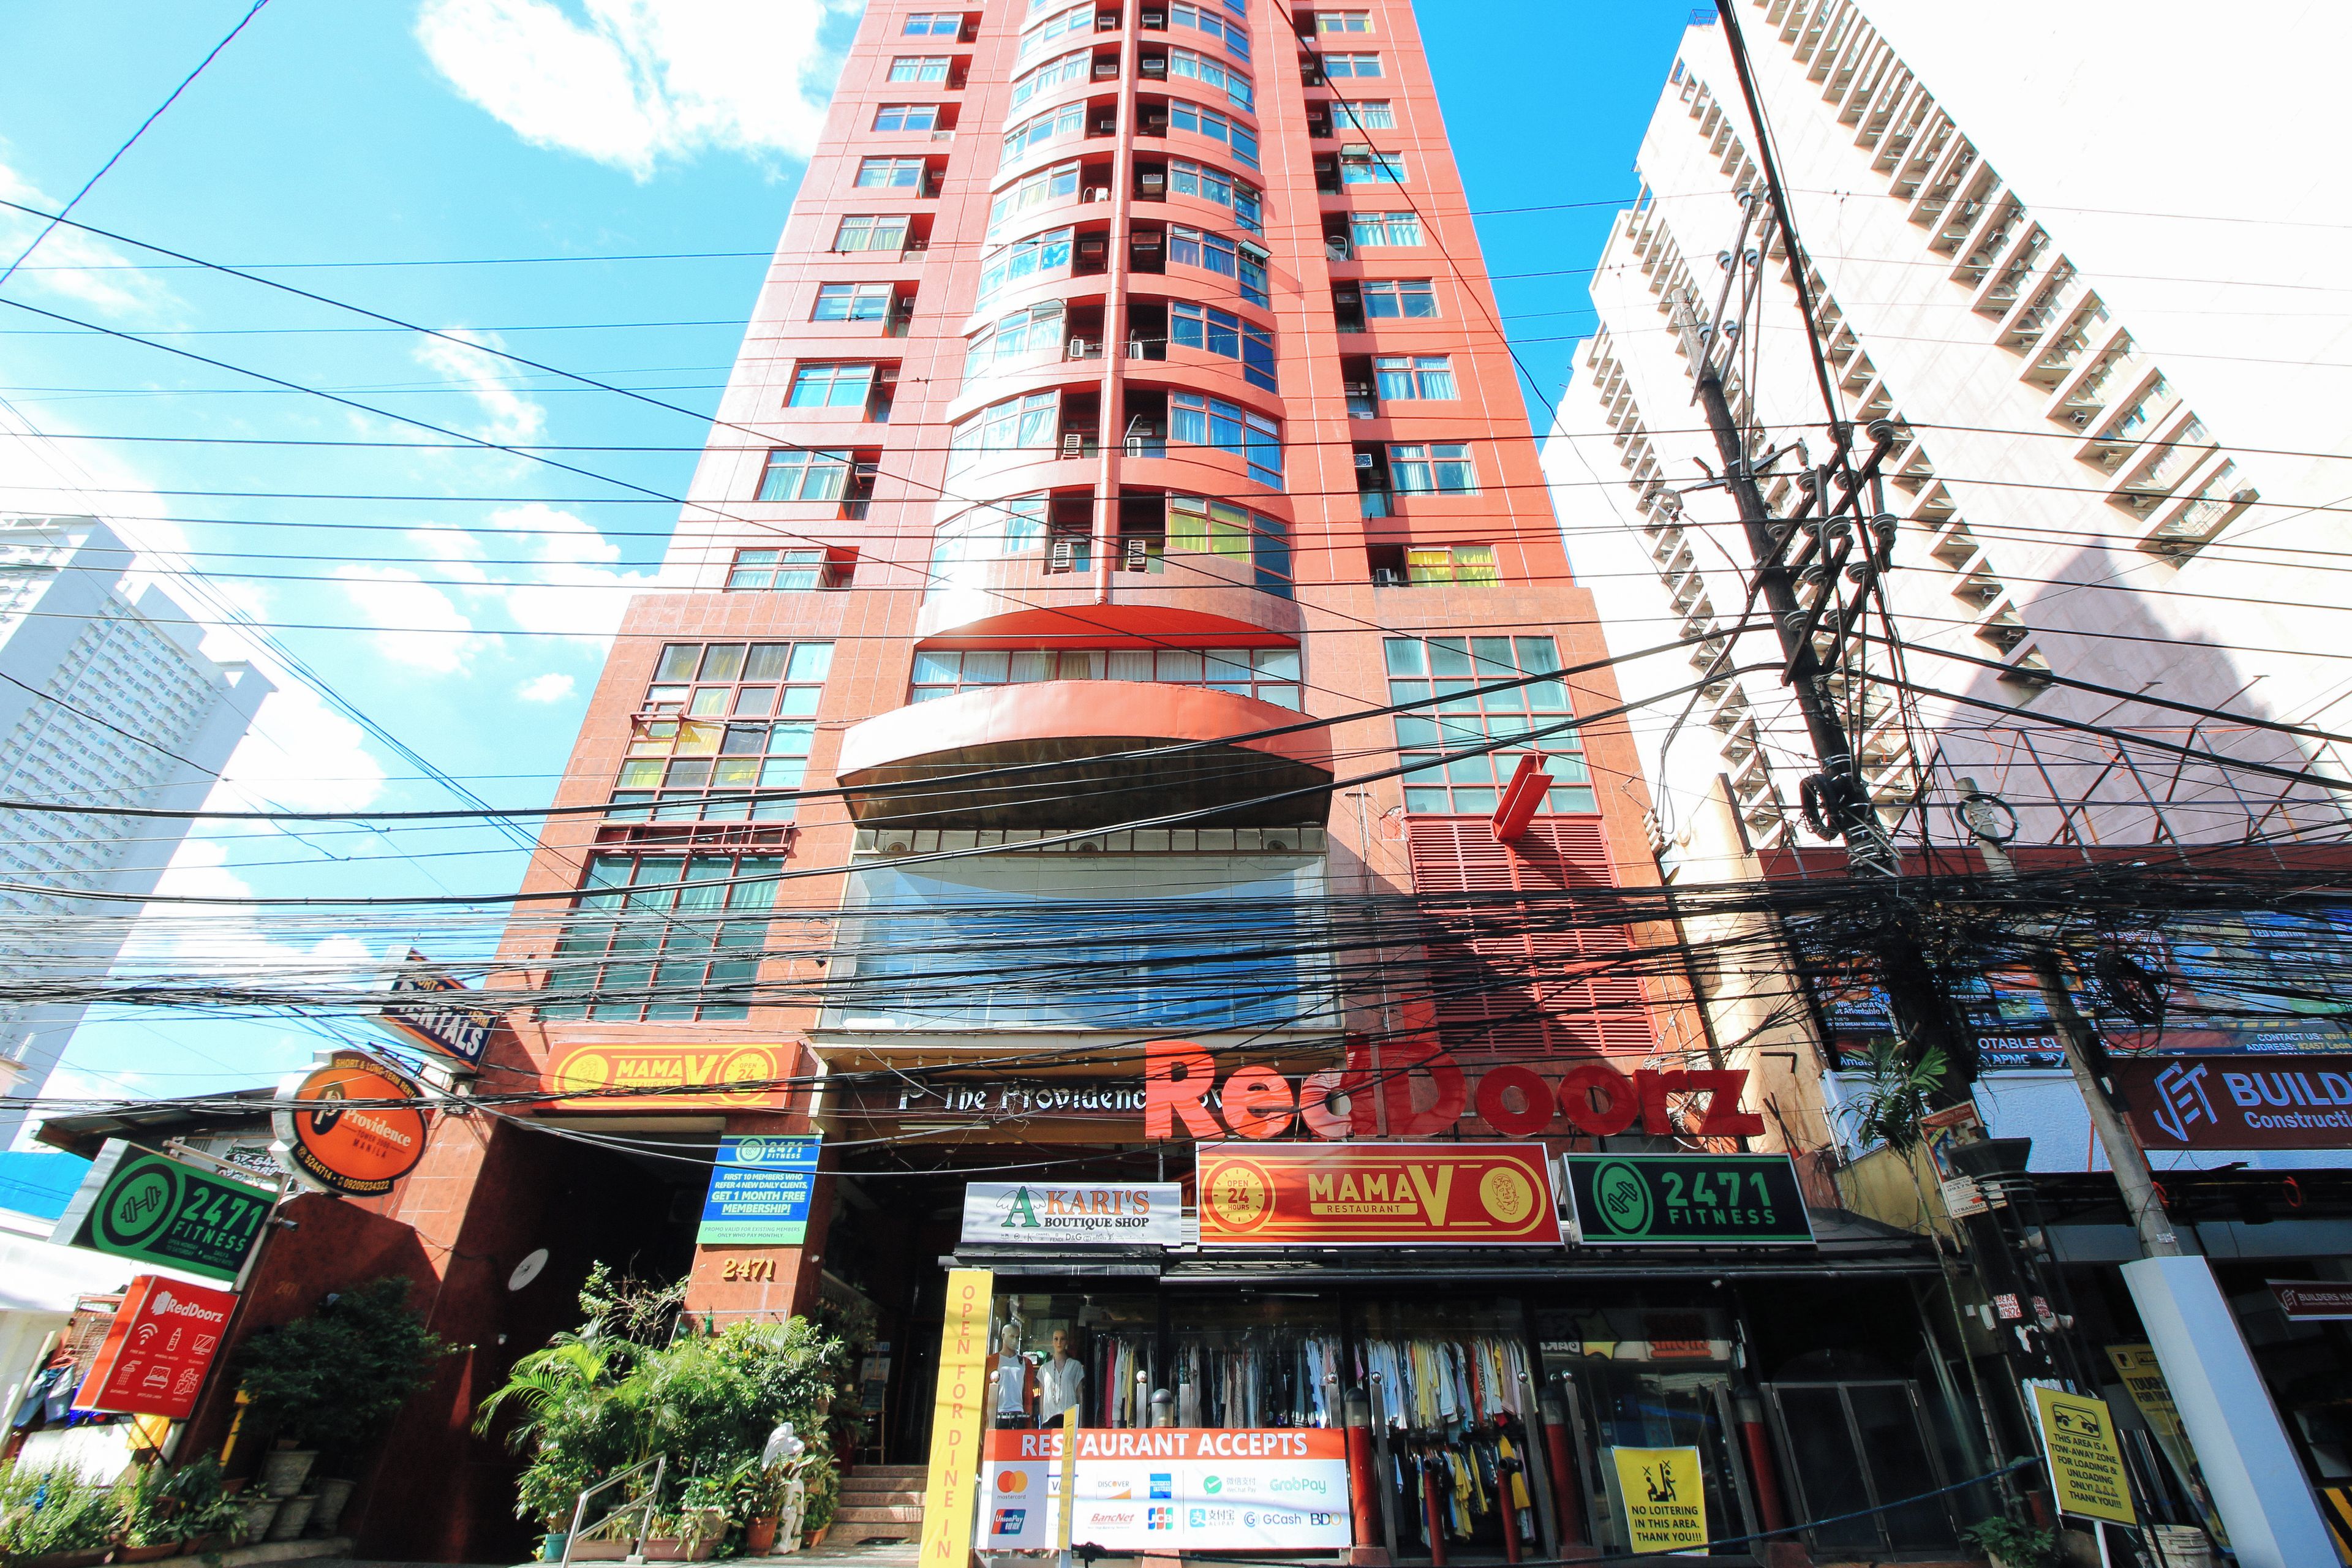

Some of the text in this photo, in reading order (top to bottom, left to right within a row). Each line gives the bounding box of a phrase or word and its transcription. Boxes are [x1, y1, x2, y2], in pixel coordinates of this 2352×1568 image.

[1978, 1038, 2039, 1049] OTABLE
[2256, 1033, 2305, 1042] CONTACT
[2245, 1043, 2297, 1052] ADDRESS:
[336, 1058, 360, 1069] SHORT
[360, 1061, 366, 1069] &
[1992, 1054, 2030, 1065] APMC
[615, 1059, 684, 1078] MAMA
[737, 1069, 755, 1081] 24
[1145, 1035, 1765, 1139] RedDoorz
[2222, 1072, 2352, 1107] BUILD
[944, 1081, 1147, 1111] The Providenc
[2244, 1109, 2352, 1129] Constructi
[343, 1109, 412, 1148] Providence
[352, 1138, 387, 1159] MANILA
[304, 1155, 333, 1181] 5244714
[711, 1191, 806, 1200] GET 1 MONTH FREE
[1227, 1188, 1250, 1204] 24
[1308, 1174, 1417, 1202] MAMA
[1661, 1172, 1772, 1207] 2471
[181, 1186, 265, 1237] 2471
[722, 1204, 791, 1213] MEMBERSHIP!
[1327, 1205, 1401, 1213] RESTAURANT
[1667, 1209, 1776, 1224] FITNESS
[1044, 1218, 1150, 1231] BOUTIQUE SHOP
[171, 1220, 247, 1253] FITNESS
[1065, 1233, 1082, 1242] D&G
[721, 1257, 774, 1278] 2471
[166, 1298, 224, 1323] RedDoorz
[956, 1285, 975, 1355] OPEN
[951, 1364, 967, 1419] FOR
[1021, 1433, 1308, 1457] RESAURANT ACCEPTS
[2052, 1432, 2108, 1452] THIS AREA IS A
[2049, 1442, 2095, 1460] TOW-AWAY
[943, 1429, 962, 1508] DINE
[2057, 1455, 2118, 1476] FOR LOADING &
[2066, 1468, 2114, 1485] UNLOADING
[1270, 1477, 1327, 1494] GrabPay
[2069, 1480, 2094, 1491] ONLY!
[2068, 1490, 2122, 1509] THANK YOU!!!
[995, 1513, 1024, 1524] UnionPay
[1090, 1513, 1135, 1523] BancNet
[1148, 1511, 1173, 1525] JCB
[1263, 1513, 1302, 1525] GCash
[1310, 1512, 1343, 1526] BDO
[1632, 1506, 1698, 1515] NO LOITERING
[1635, 1519, 1700, 1528] IN THIS AREA.
[937, 1519, 951, 1559] IN
[1636, 1532, 1702, 1542] THANK YOU!!!
